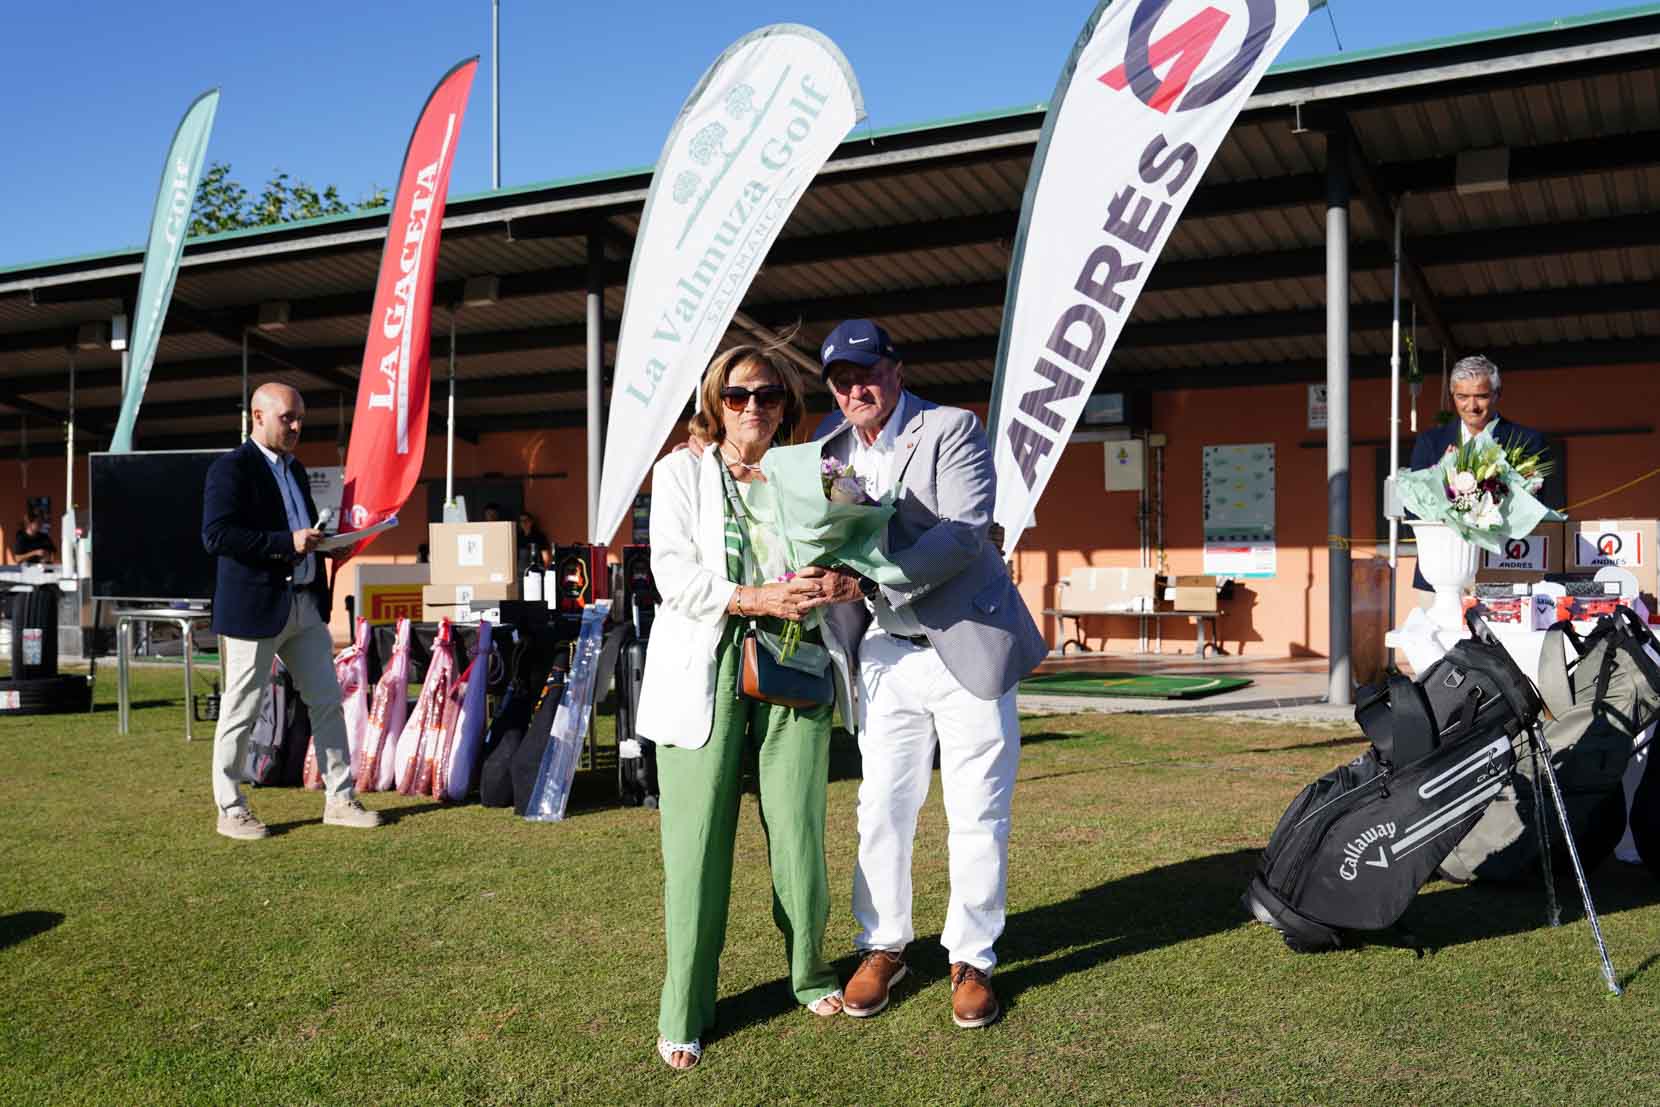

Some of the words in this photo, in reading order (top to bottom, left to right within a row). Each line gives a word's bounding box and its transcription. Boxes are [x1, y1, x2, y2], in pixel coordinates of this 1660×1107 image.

[368, 345, 400, 411] LA
[384, 160, 440, 340] GACETA
[625, 357, 669, 408] La
[653, 180, 769, 343] Valmuza
[760, 74, 830, 170] Golf
[707, 194, 791, 323] SALAMANCA
[1006, 133, 1198, 492] ANDRÉS
[372, 592, 423, 620] PIRE
[1339, 821, 1397, 881] Callaway
